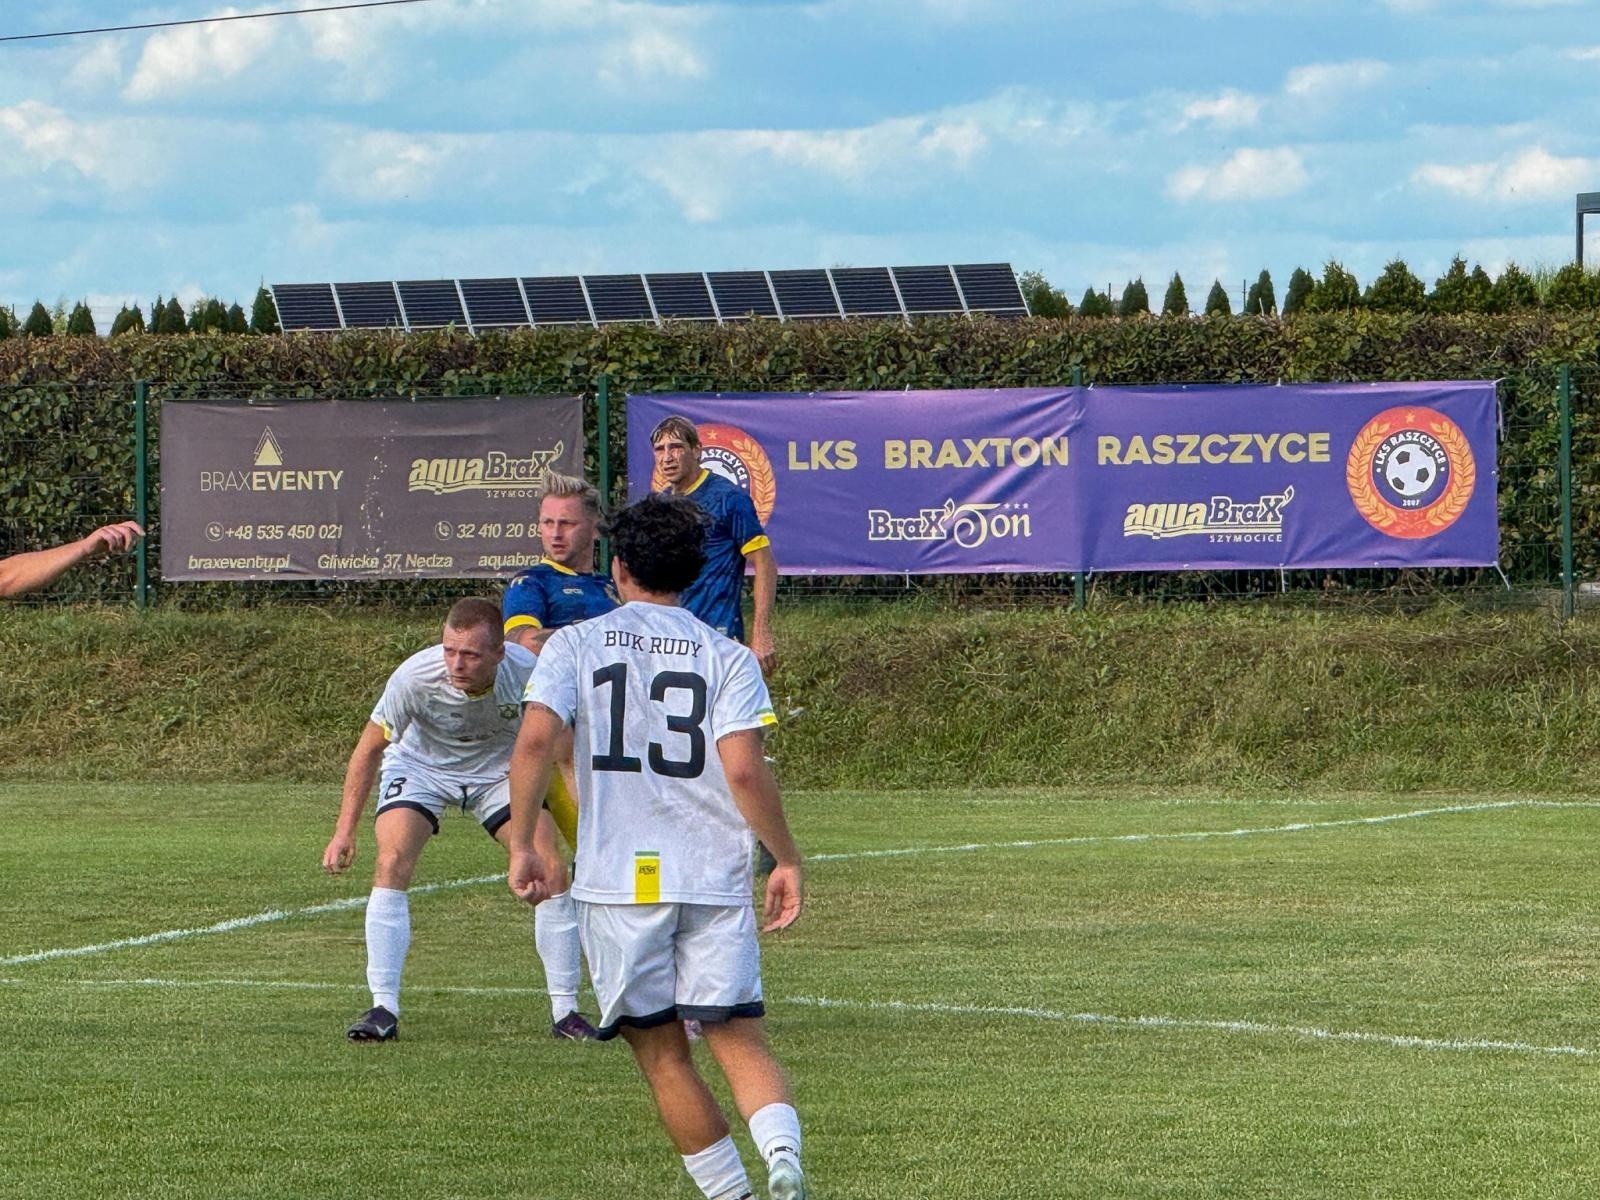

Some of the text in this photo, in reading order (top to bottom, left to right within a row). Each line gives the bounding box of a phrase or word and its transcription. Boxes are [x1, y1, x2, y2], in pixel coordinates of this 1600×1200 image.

[788, 432, 1331, 471] LKS BRAXTON RASZCZYCE
[1375, 432, 1447, 465] LKS RASZCZYCE
[700, 449, 748, 480] ASZCZYCE
[200, 470, 344, 492] BRAXEVENTY
[487, 490, 538, 498] SZYMOCI
[225, 524, 343, 540] +48 535 450 021
[456, 523, 476, 539] 32
[478, 523, 502, 538] 410
[504, 523, 524, 538] 20
[1209, 533, 1283, 543] SZYMOCICE
[188, 554, 291, 573] braxeventy.pl
[478, 552, 544, 570] aquabra
[604, 630, 703, 658] BUK RUDY
[592, 662, 707, 780] 13
